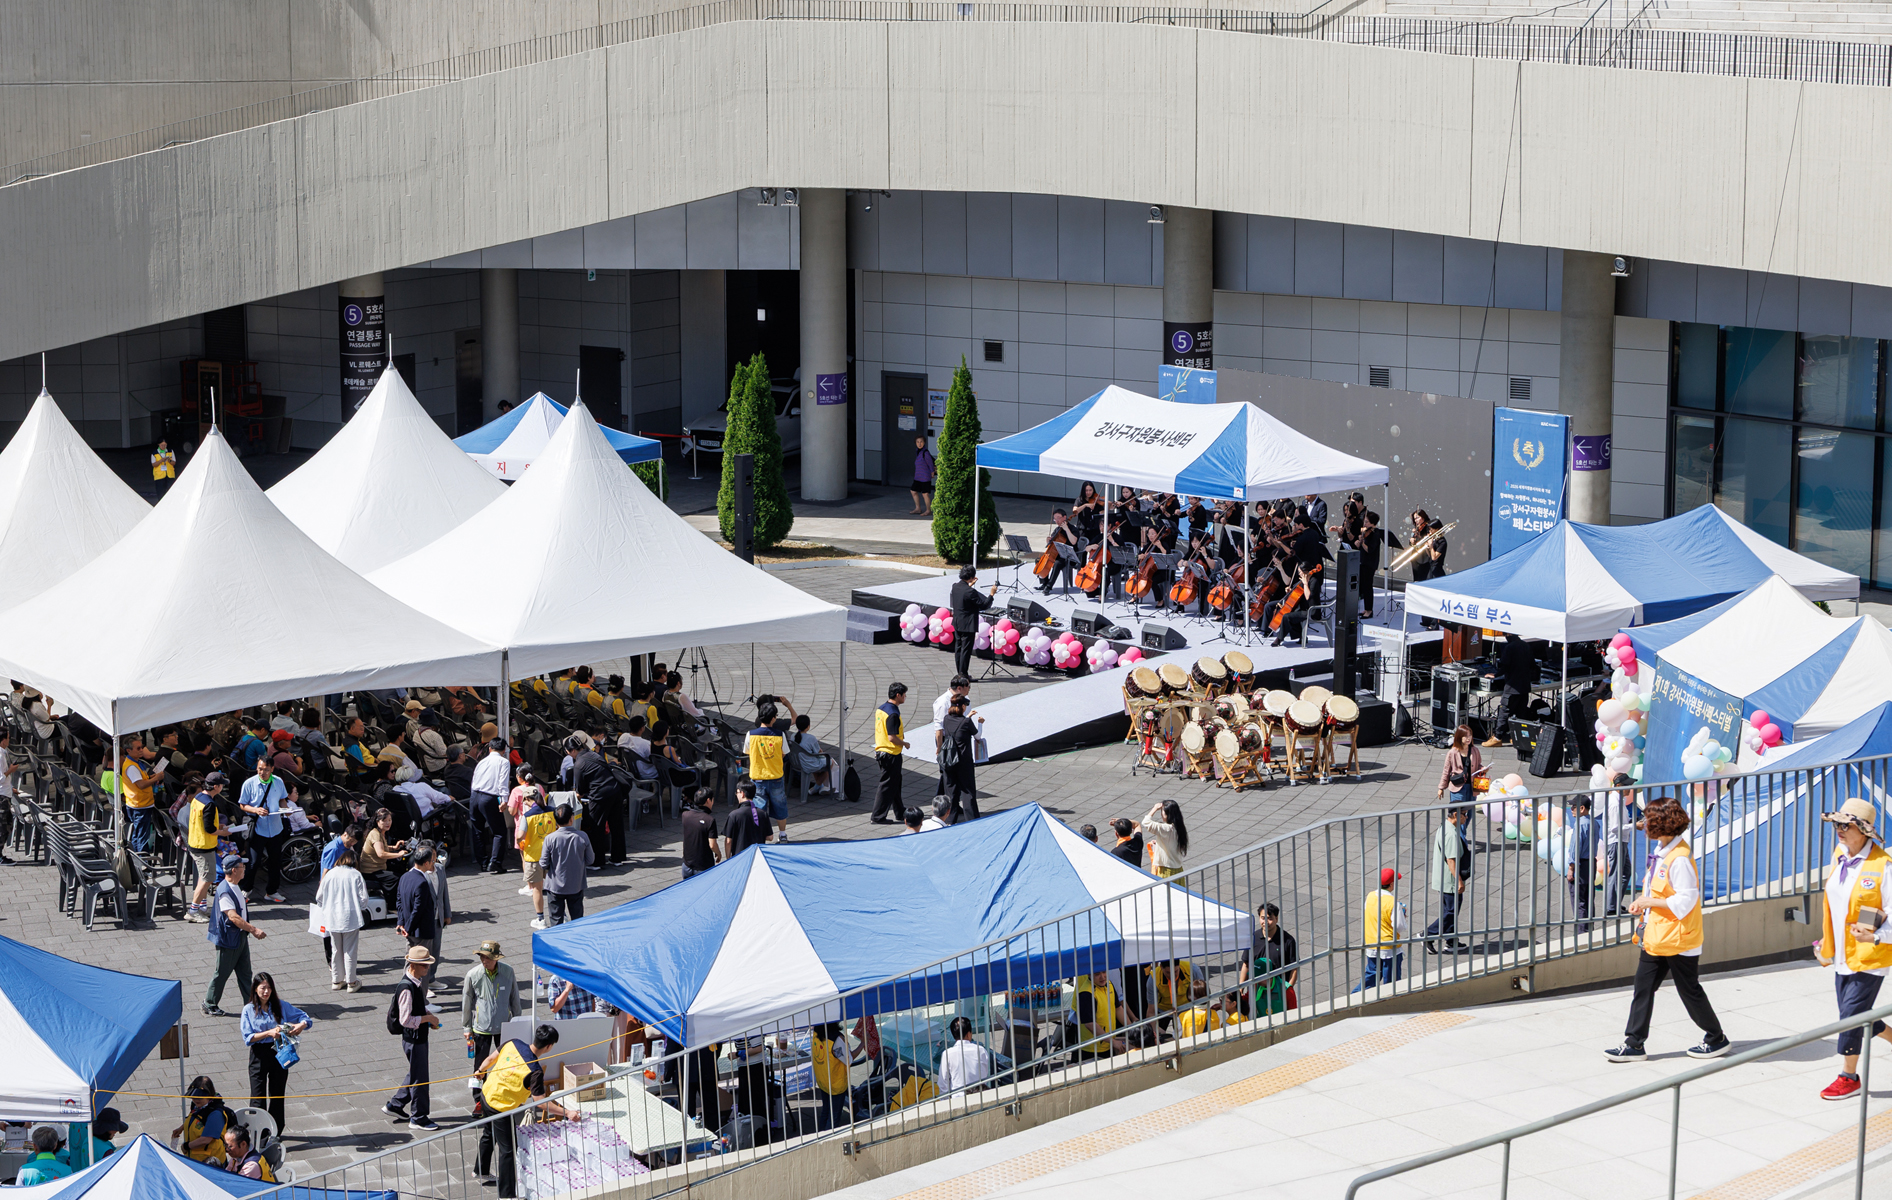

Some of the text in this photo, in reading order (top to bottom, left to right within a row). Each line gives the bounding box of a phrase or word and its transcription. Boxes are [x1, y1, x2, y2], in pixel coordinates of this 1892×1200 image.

[348, 308, 358, 322] 5
[347, 330, 382, 341] 연결통로
[1177, 334, 1187, 349] 5
[343, 378, 366, 386] 롯데캐슬
[1094, 421, 1197, 449] 강서구자원봉사센터
[1522, 440, 1535, 458] 축
[1604, 441, 1611, 456] 5
[1511, 502, 1556, 519] 강서구자원봉사
[1440, 599, 1512, 626] 시스템 부스
[1654, 675, 1734, 733] 제1회 강서구자원봉사페스티벌
